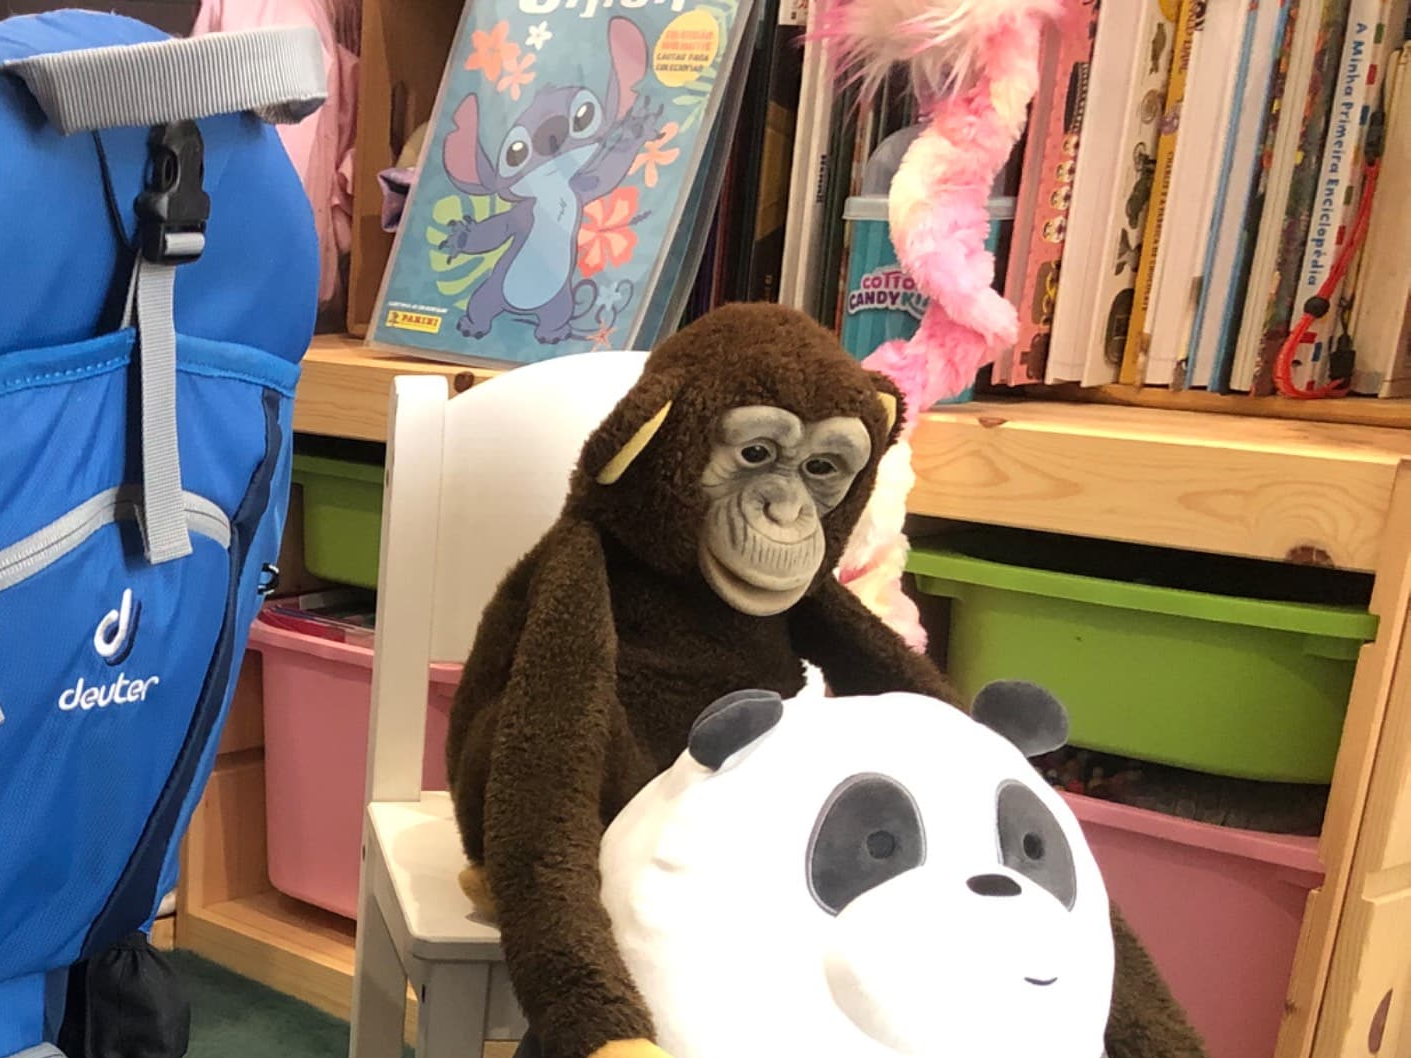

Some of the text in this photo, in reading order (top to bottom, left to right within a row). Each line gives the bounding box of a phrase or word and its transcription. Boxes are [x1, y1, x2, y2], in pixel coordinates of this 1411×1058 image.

[1306, 22, 1368, 286] A Minha Primeira Enciclopédia
[862, 270, 916, 290] COTTO
[849, 290, 900, 310] CANDY
[401, 314, 439, 327] PANINI
[58, 672, 160, 711] deuter
